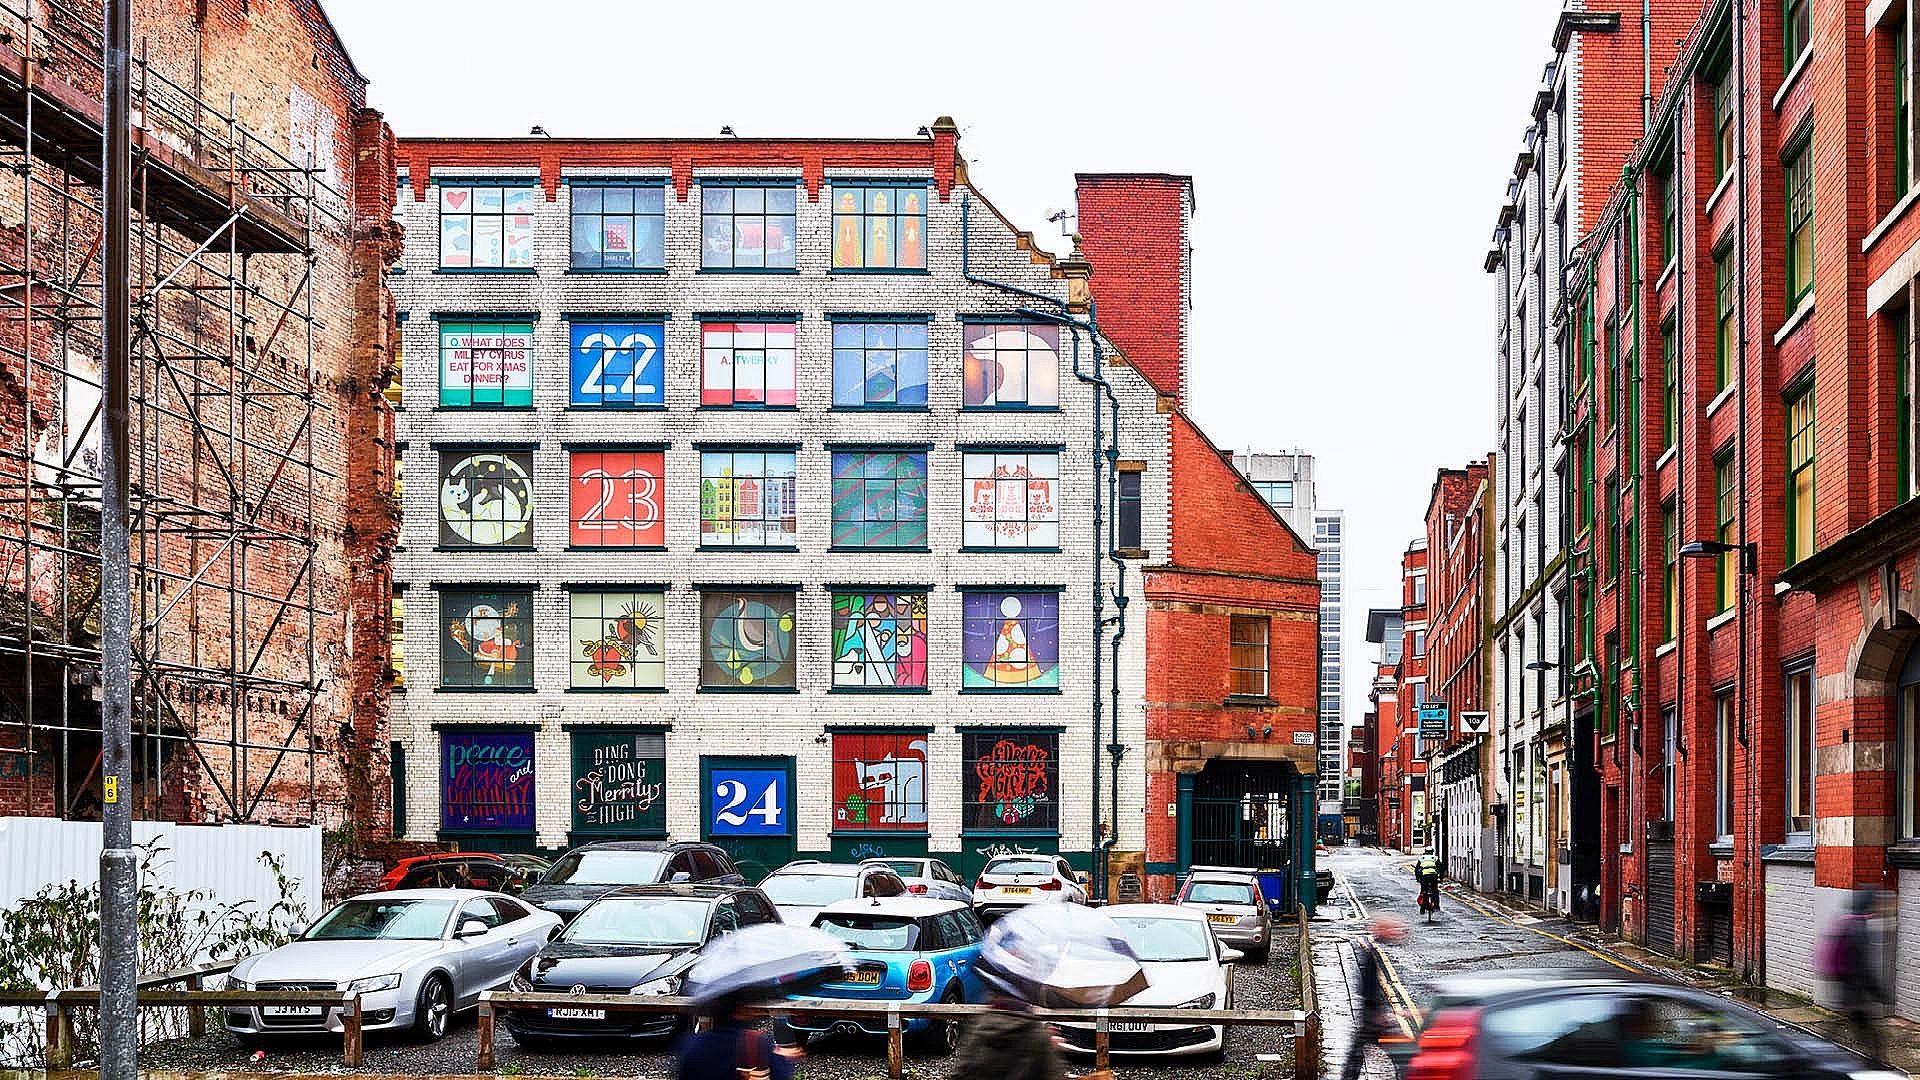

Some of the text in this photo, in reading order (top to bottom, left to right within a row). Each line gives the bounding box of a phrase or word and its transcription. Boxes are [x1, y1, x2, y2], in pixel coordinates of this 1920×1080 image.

[461, 338, 492, 347] WHAT
[495, 338, 525, 347] DOES
[449, 362, 527, 372] EAT FOR XMAS
[454, 351, 525, 360] MILEY CYRUS
[580, 333, 656, 394] 22
[720, 355, 731, 365] A.
[578, 469, 659, 529] 23
[449, 744, 528, 779] peace
[594, 744, 629, 766] DING
[509, 759, 534, 783] and
[608, 760, 646, 783] DONG
[576, 771, 662, 811] Merrily
[716, 778, 782, 826] 24
[599, 804, 635, 824] HIGH
